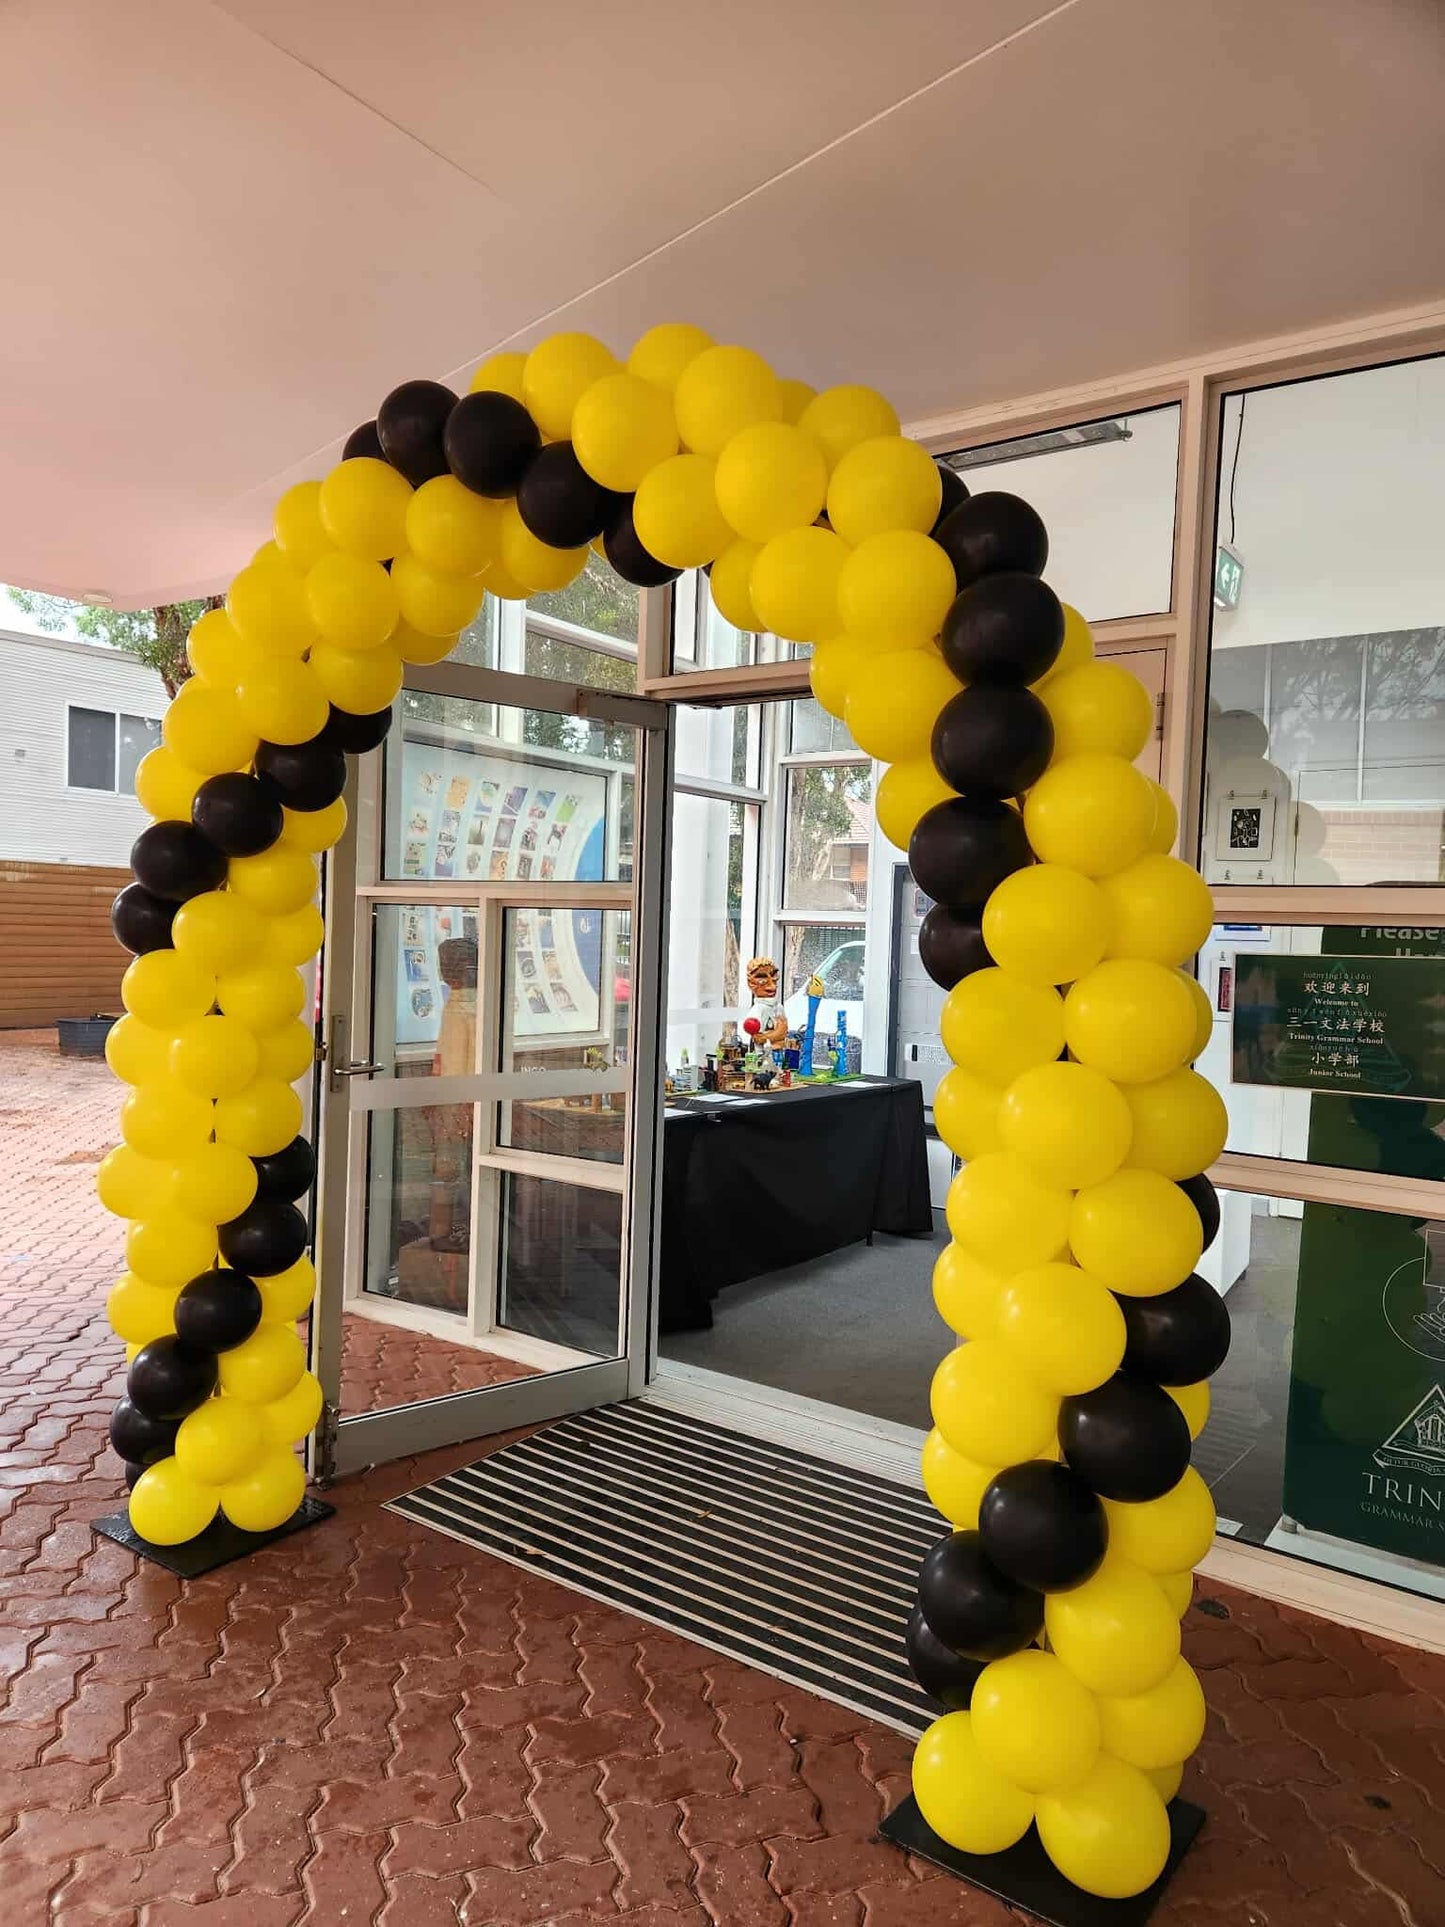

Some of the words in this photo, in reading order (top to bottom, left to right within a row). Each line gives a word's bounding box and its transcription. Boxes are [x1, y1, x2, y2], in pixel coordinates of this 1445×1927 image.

[1304, 980, 1369, 996] 欢迎来到
[1314, 998, 1348, 1006] Welcome
[1286, 1017, 1385, 1033] 三一文法学校
[1289, 1032, 1314, 1041] Trinity
[1317, 1034, 1354, 1043] Grammar
[1357, 1036, 1383, 1044] School
[1311, 1052, 1359, 1067] 小学部
[1309, 1068, 1333, 1076] Junior
[1335, 1070, 1361, 1078] School
[1361, 1472, 1442, 1511] TRIN
[1360, 1502, 1433, 1529] GRAMMAR
